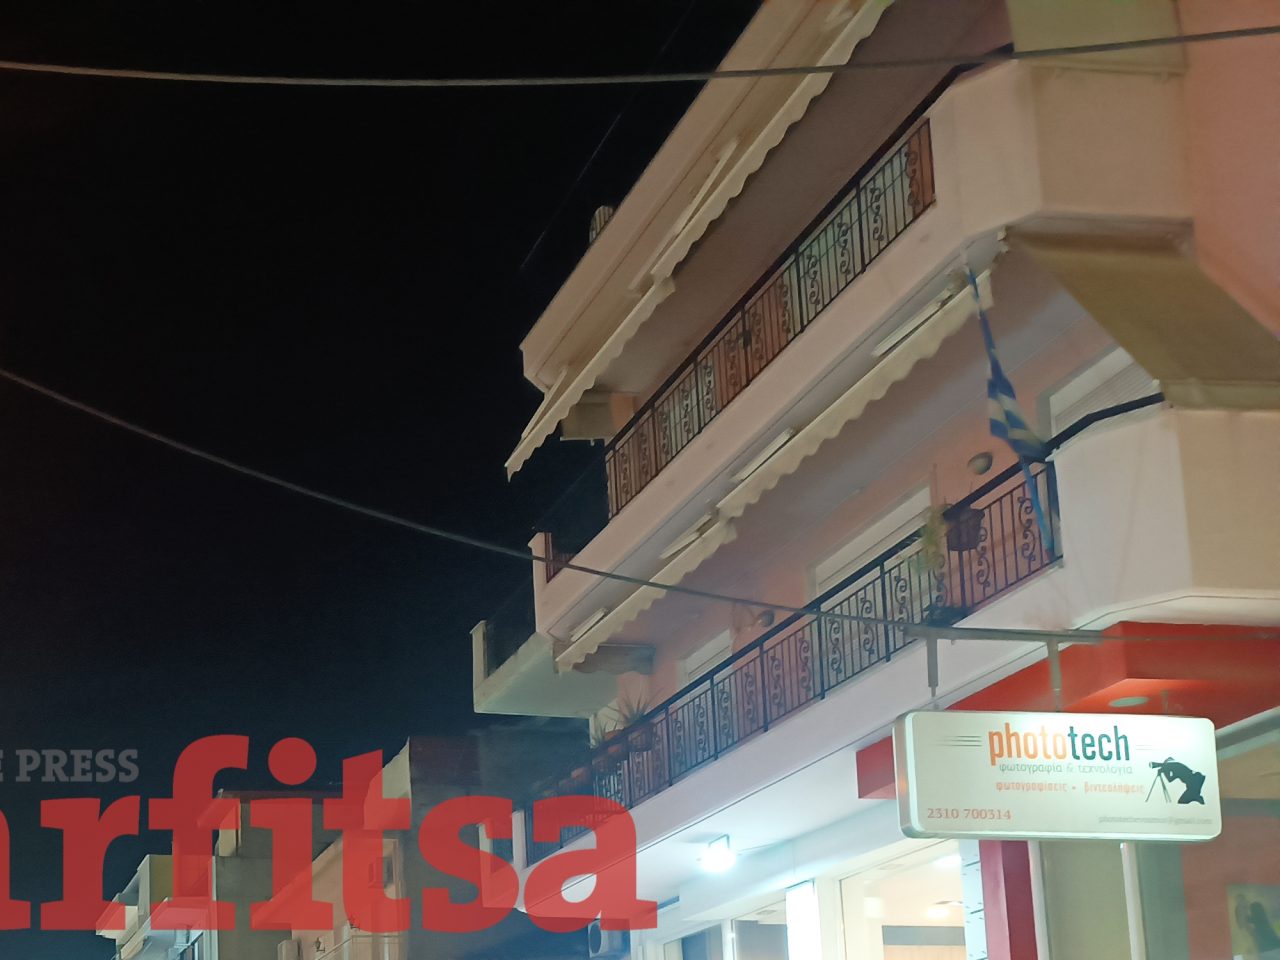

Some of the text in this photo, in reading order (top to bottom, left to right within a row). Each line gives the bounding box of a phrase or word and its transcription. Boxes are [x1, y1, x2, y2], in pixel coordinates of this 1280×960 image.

[988, 722, 1130, 766] phototech
[927, 807, 1012, 820] 2310 700314
